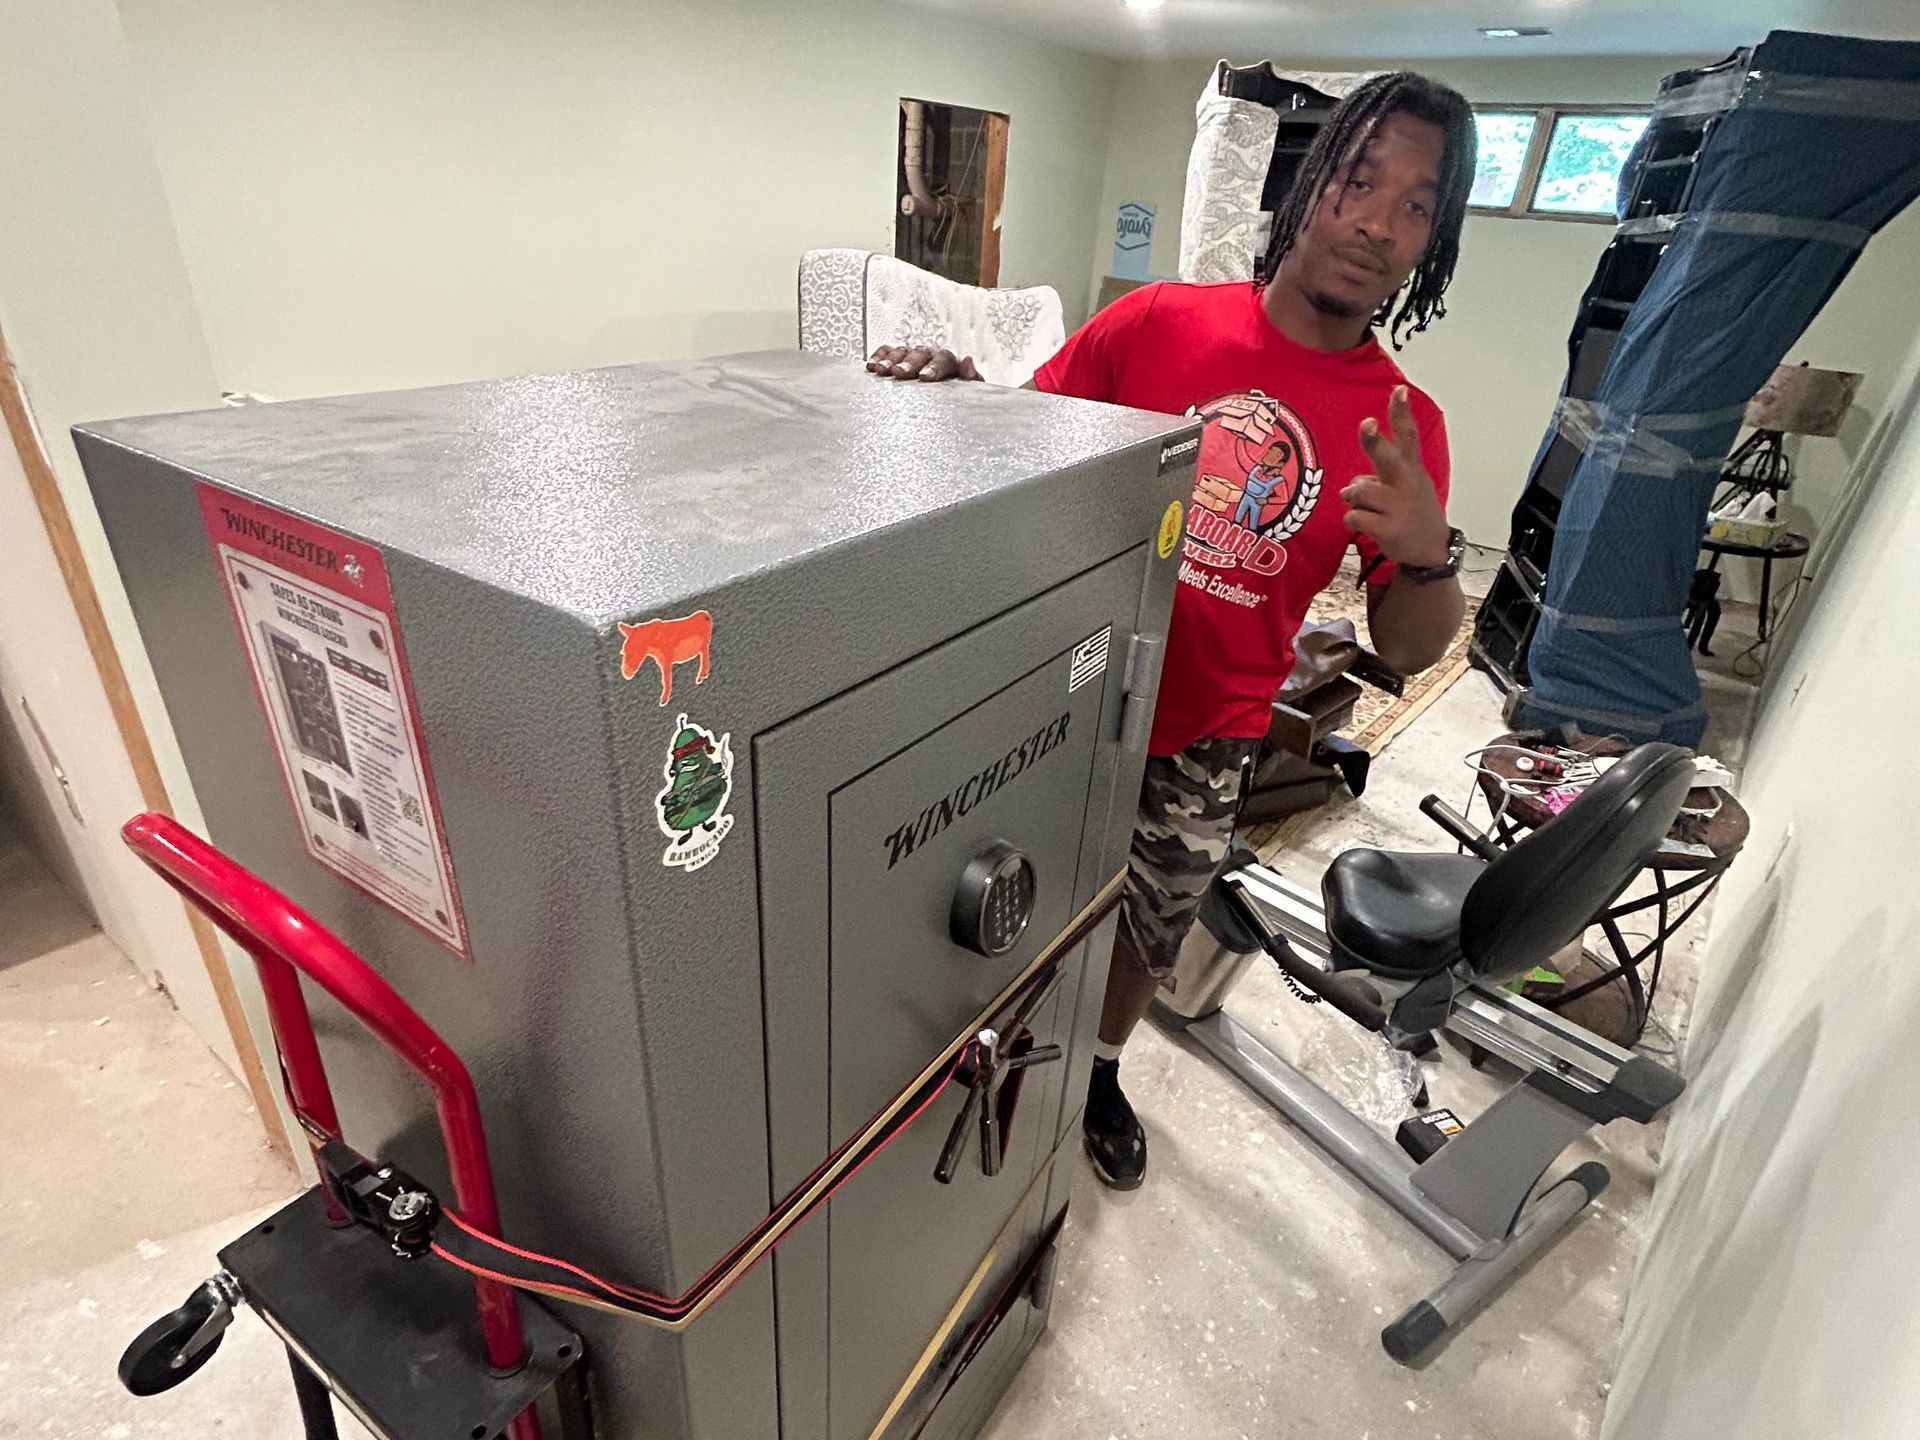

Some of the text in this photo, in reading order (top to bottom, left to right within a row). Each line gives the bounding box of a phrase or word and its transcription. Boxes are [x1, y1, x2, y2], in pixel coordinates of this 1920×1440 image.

[1166, 437, 1199, 457] VEDDER
[220, 507, 339, 573] WINCHESTER
[1182, 538, 1237, 568] VERZ
[1186, 504, 1288, 576] ABOARD
[270, 582, 297, 605] SAFES
[296, 594, 309, 610] AS
[1178, 561, 1262, 609] Meets Excellence
[884, 709, 1071, 871] WINCHESTER
[669, 819, 730, 862] RAMBOCADO
